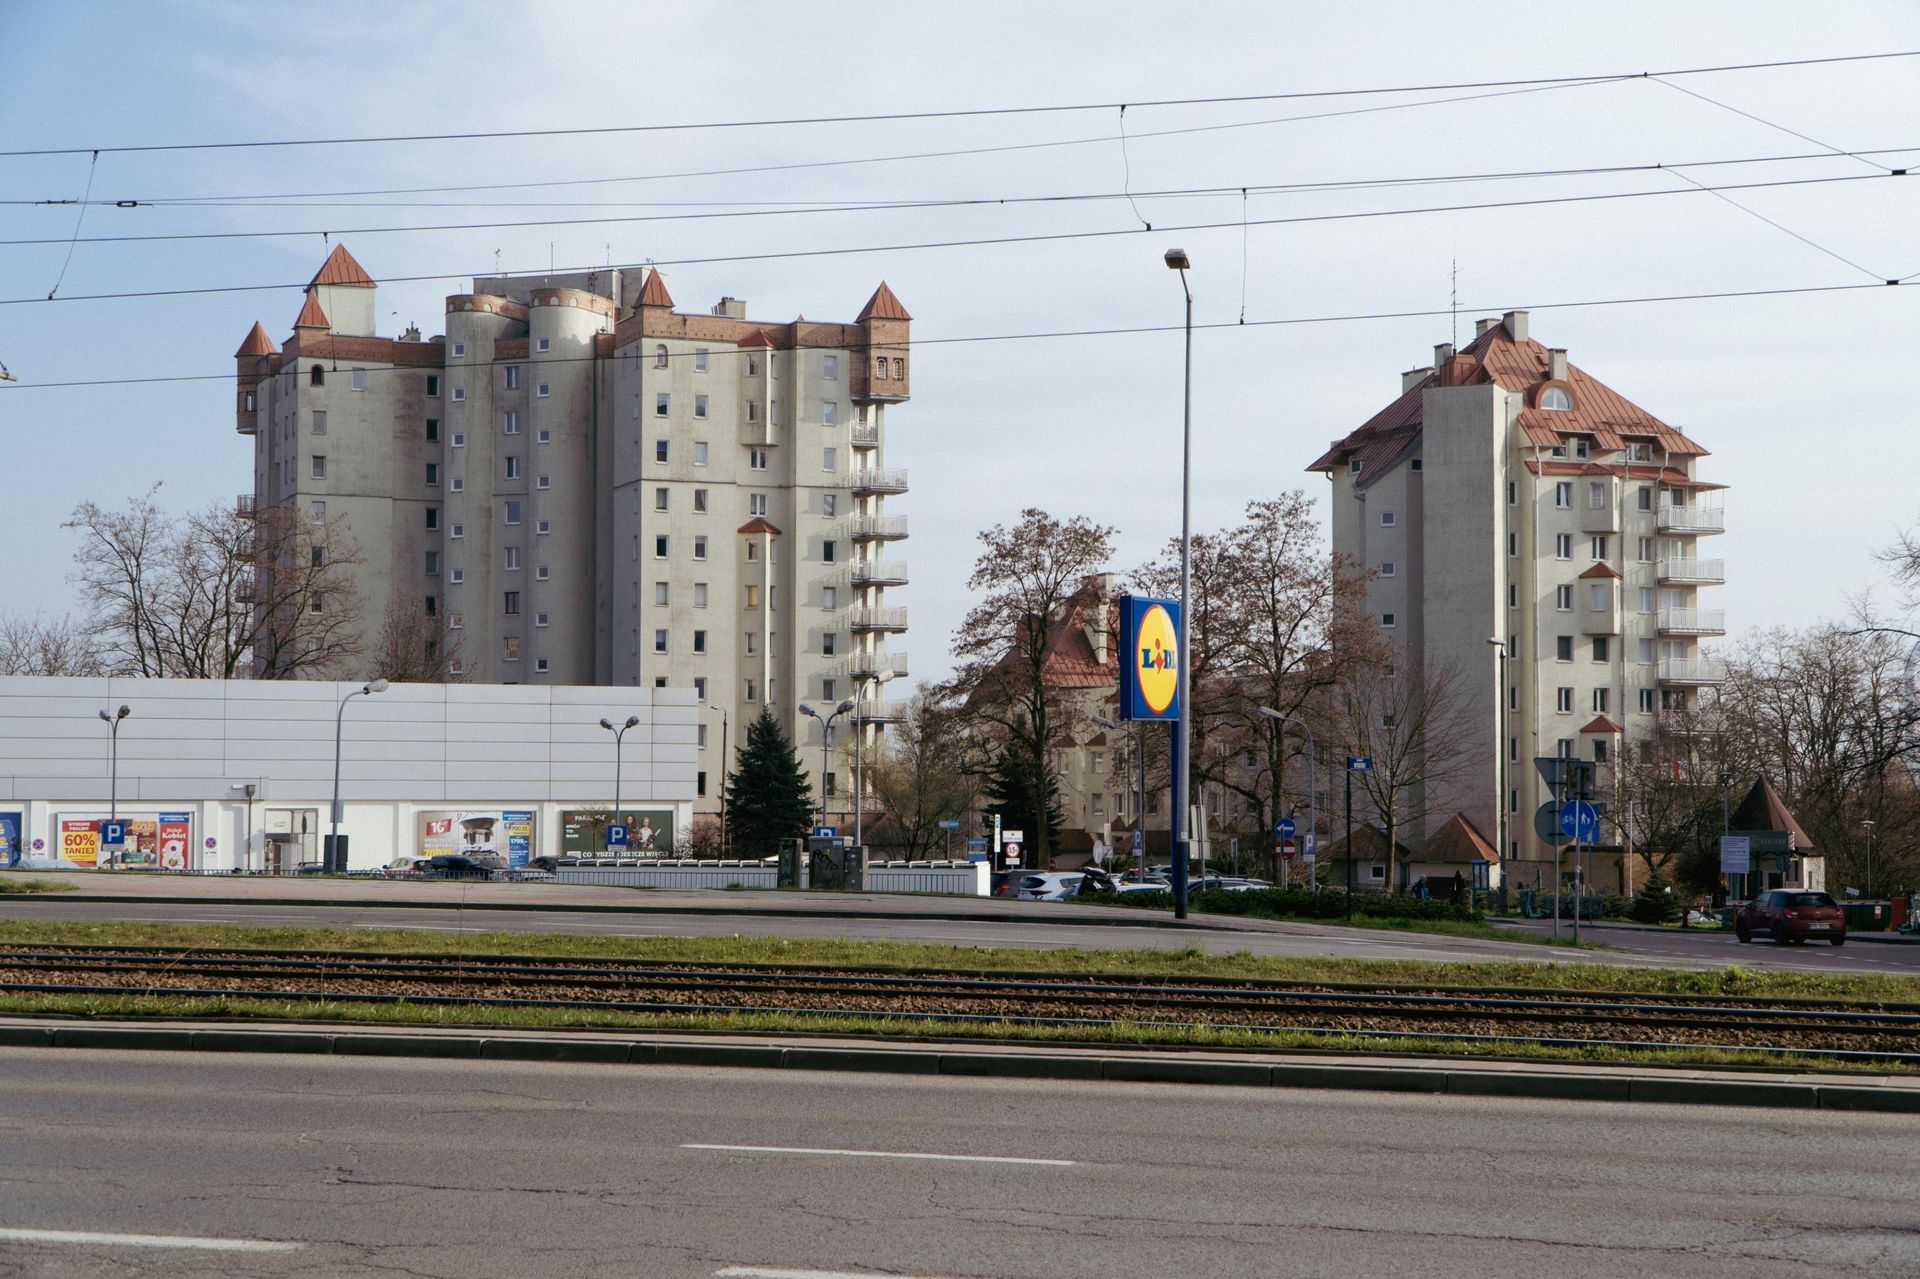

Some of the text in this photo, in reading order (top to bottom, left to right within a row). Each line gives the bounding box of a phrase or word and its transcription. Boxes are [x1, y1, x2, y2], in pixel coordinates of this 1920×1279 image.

[64, 834, 95, 847] 60%
[108, 824, 121, 842] P
[611, 827, 624, 843] P
[1134, 831, 1141, 848] P
[64, 847, 94, 855] TANIEJ
[1306, 834, 1313, 852] P
